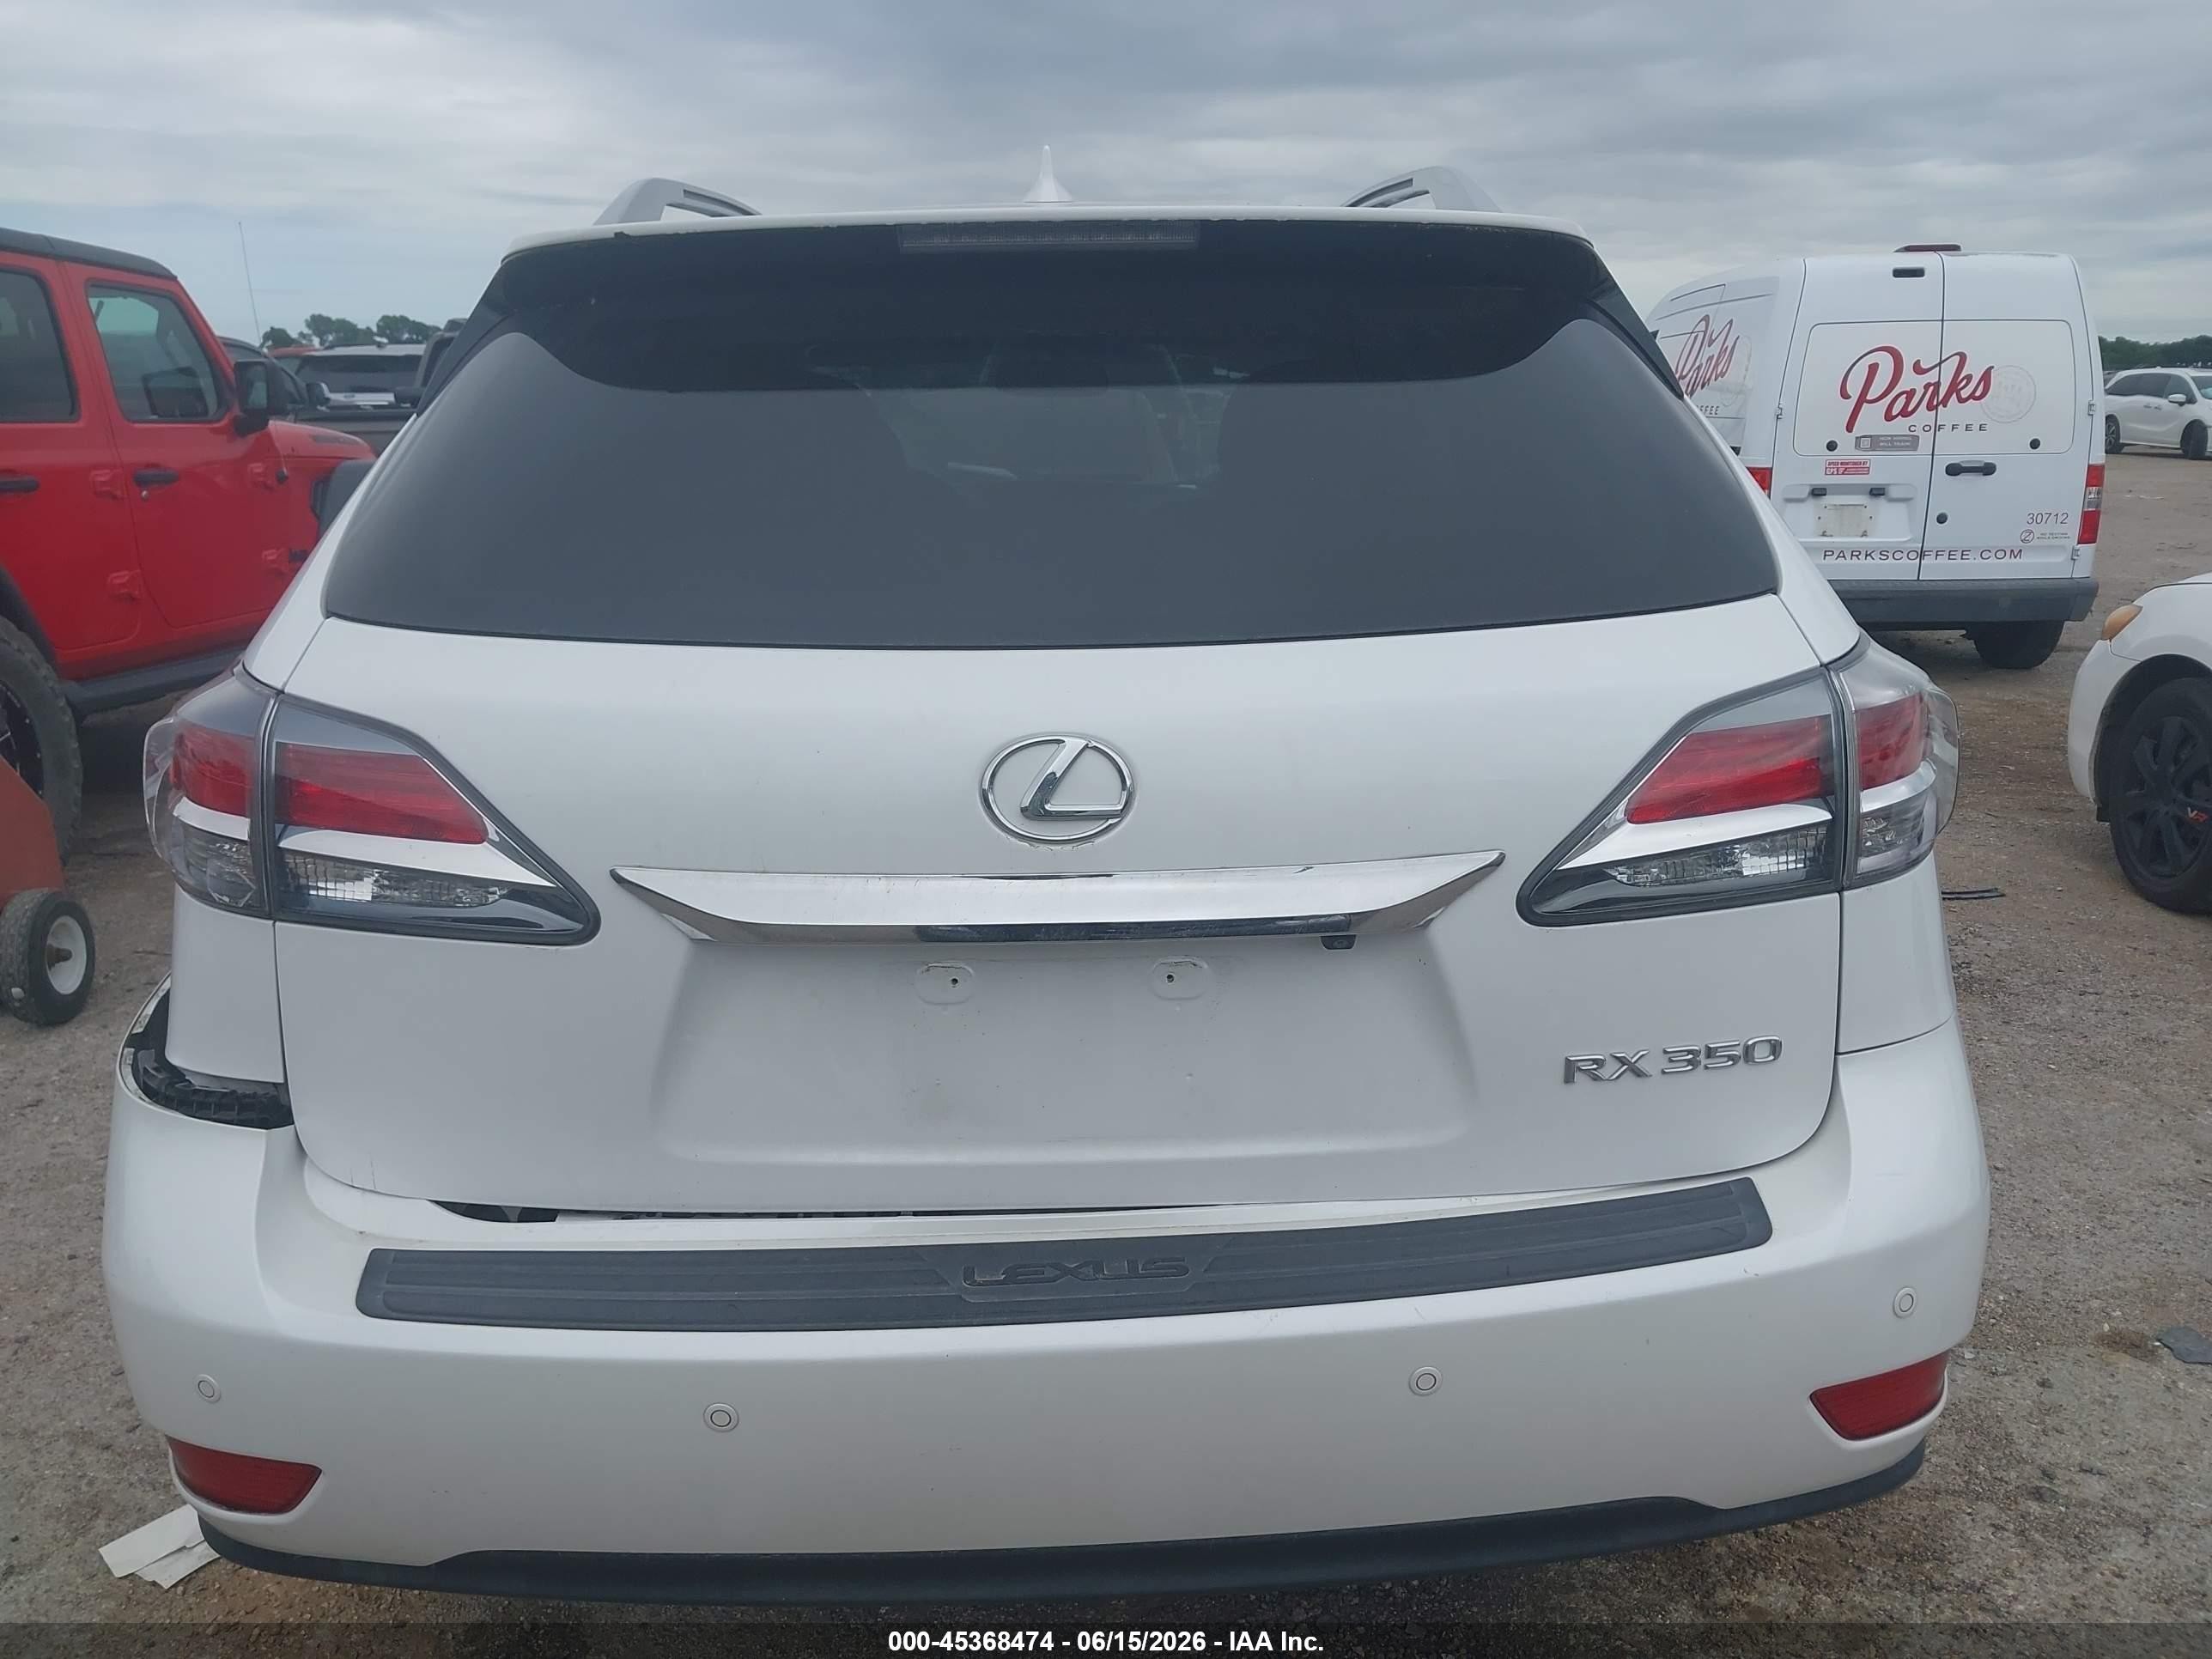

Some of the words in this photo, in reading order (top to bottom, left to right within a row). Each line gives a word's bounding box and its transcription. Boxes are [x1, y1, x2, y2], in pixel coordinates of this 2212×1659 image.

[1839, 345, 1995, 434] Parks
[1908, 423, 1989, 433] COFFEE
[2027, 513, 2069, 525] 30712
[1823, 549, 2023, 561] PARKSCOFFEE.COM
[1564, 1049, 1653, 1084] RX
[1661, 1034, 1783, 1075] 350
[962, 1256, 1190, 1287] LEXUS
